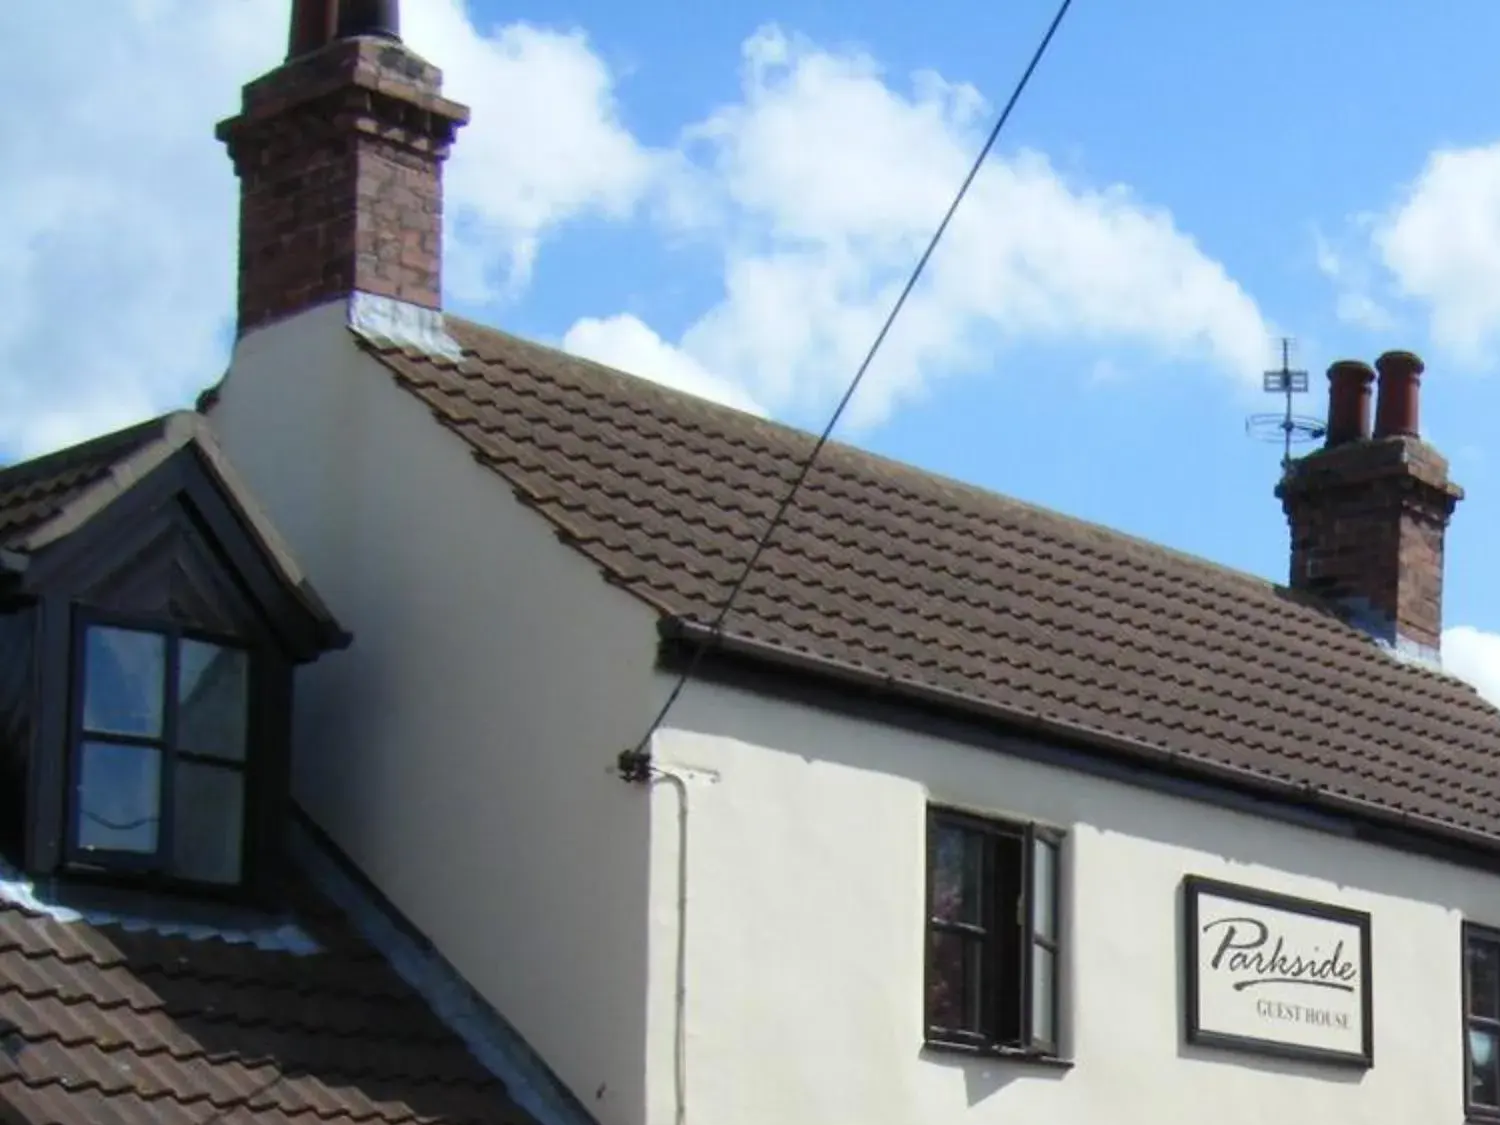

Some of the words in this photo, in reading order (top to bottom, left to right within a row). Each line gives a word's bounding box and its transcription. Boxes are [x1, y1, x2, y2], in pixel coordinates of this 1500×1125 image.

[1203, 917, 1357, 981] Parkside
[1256, 999, 1301, 1021] GUEST
[1304, 1006, 1351, 1029] HOUSE
